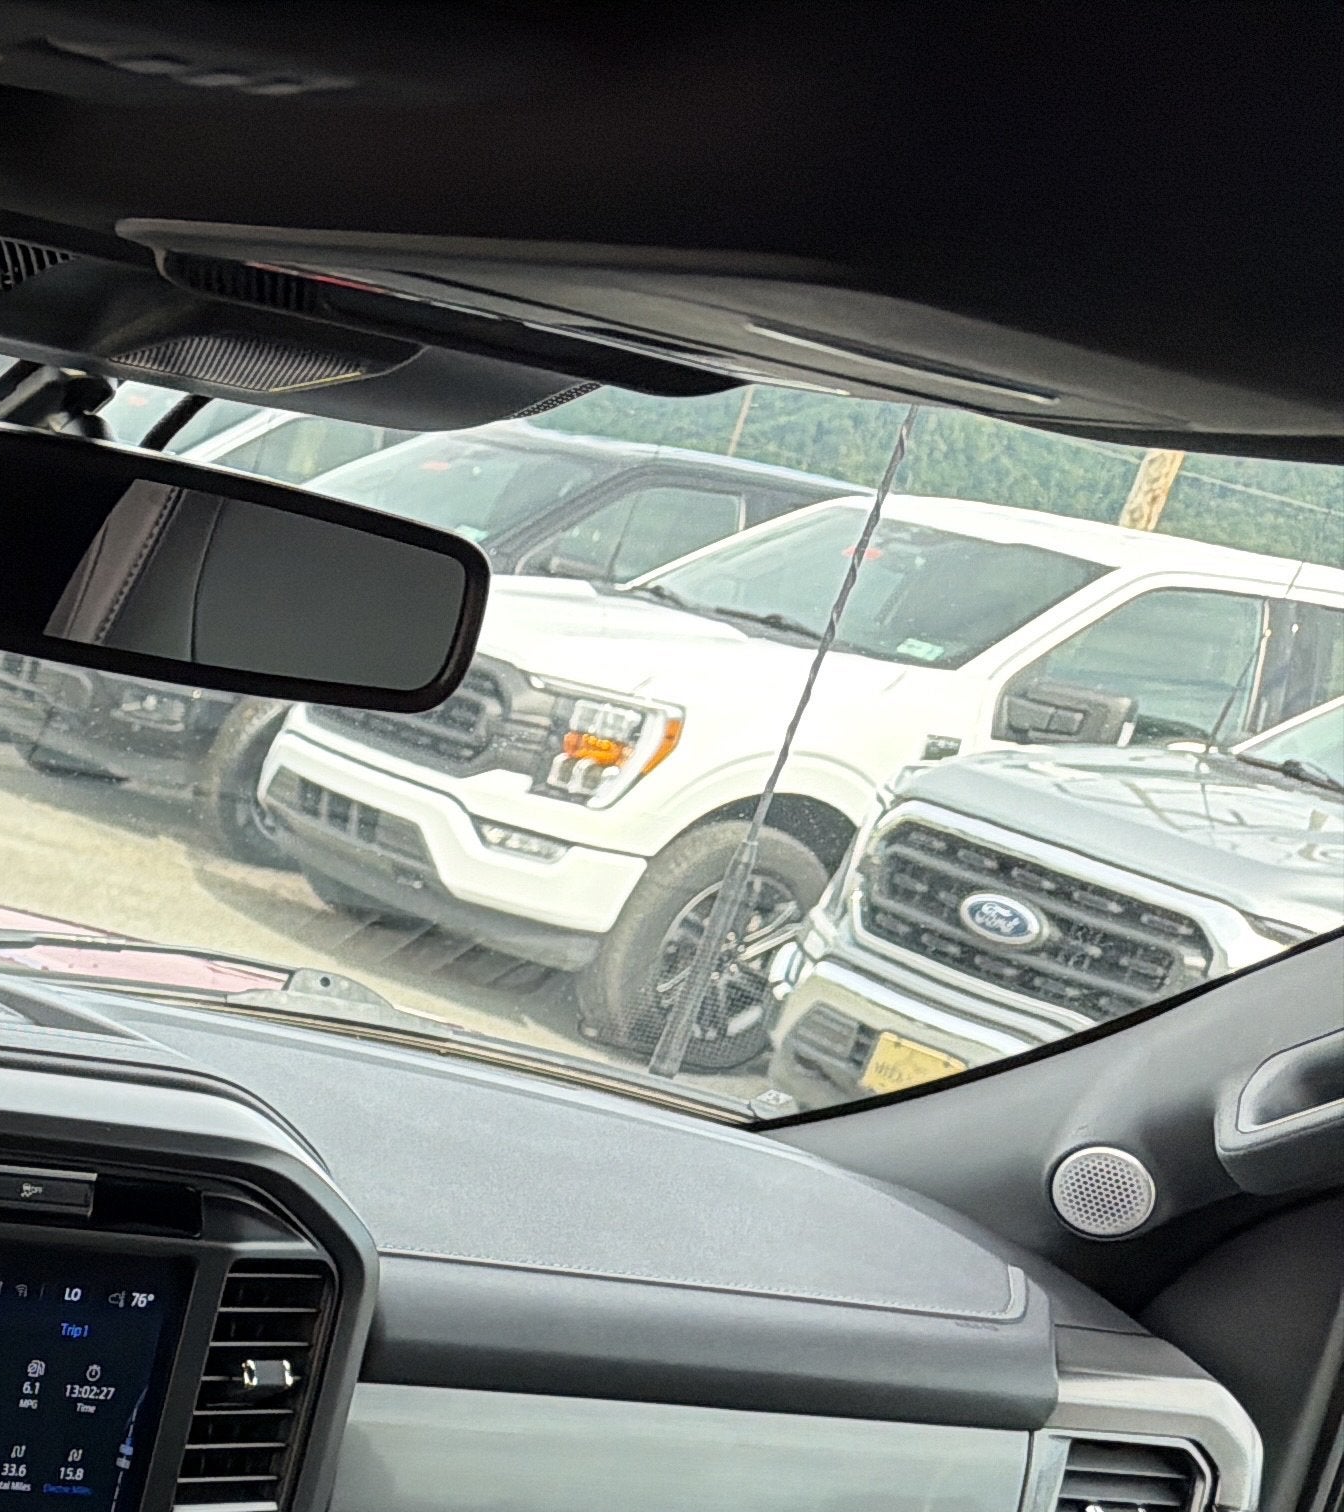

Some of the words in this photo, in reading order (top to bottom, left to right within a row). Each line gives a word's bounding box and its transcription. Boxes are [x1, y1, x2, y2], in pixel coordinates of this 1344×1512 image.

[975, 903, 1020, 933] Ford
[64, 1288, 82, 1301] LO
[61, 1323, 82, 1338] Trip
[23, 1382, 40, 1394] 6.1
[65, 1384, 115, 1400] 13:02:27
[77, 1403, 96, 1413] Time
[1, 1463, 27, 1477] 33.6
[60, 1467, 84, 1480] 15.8
